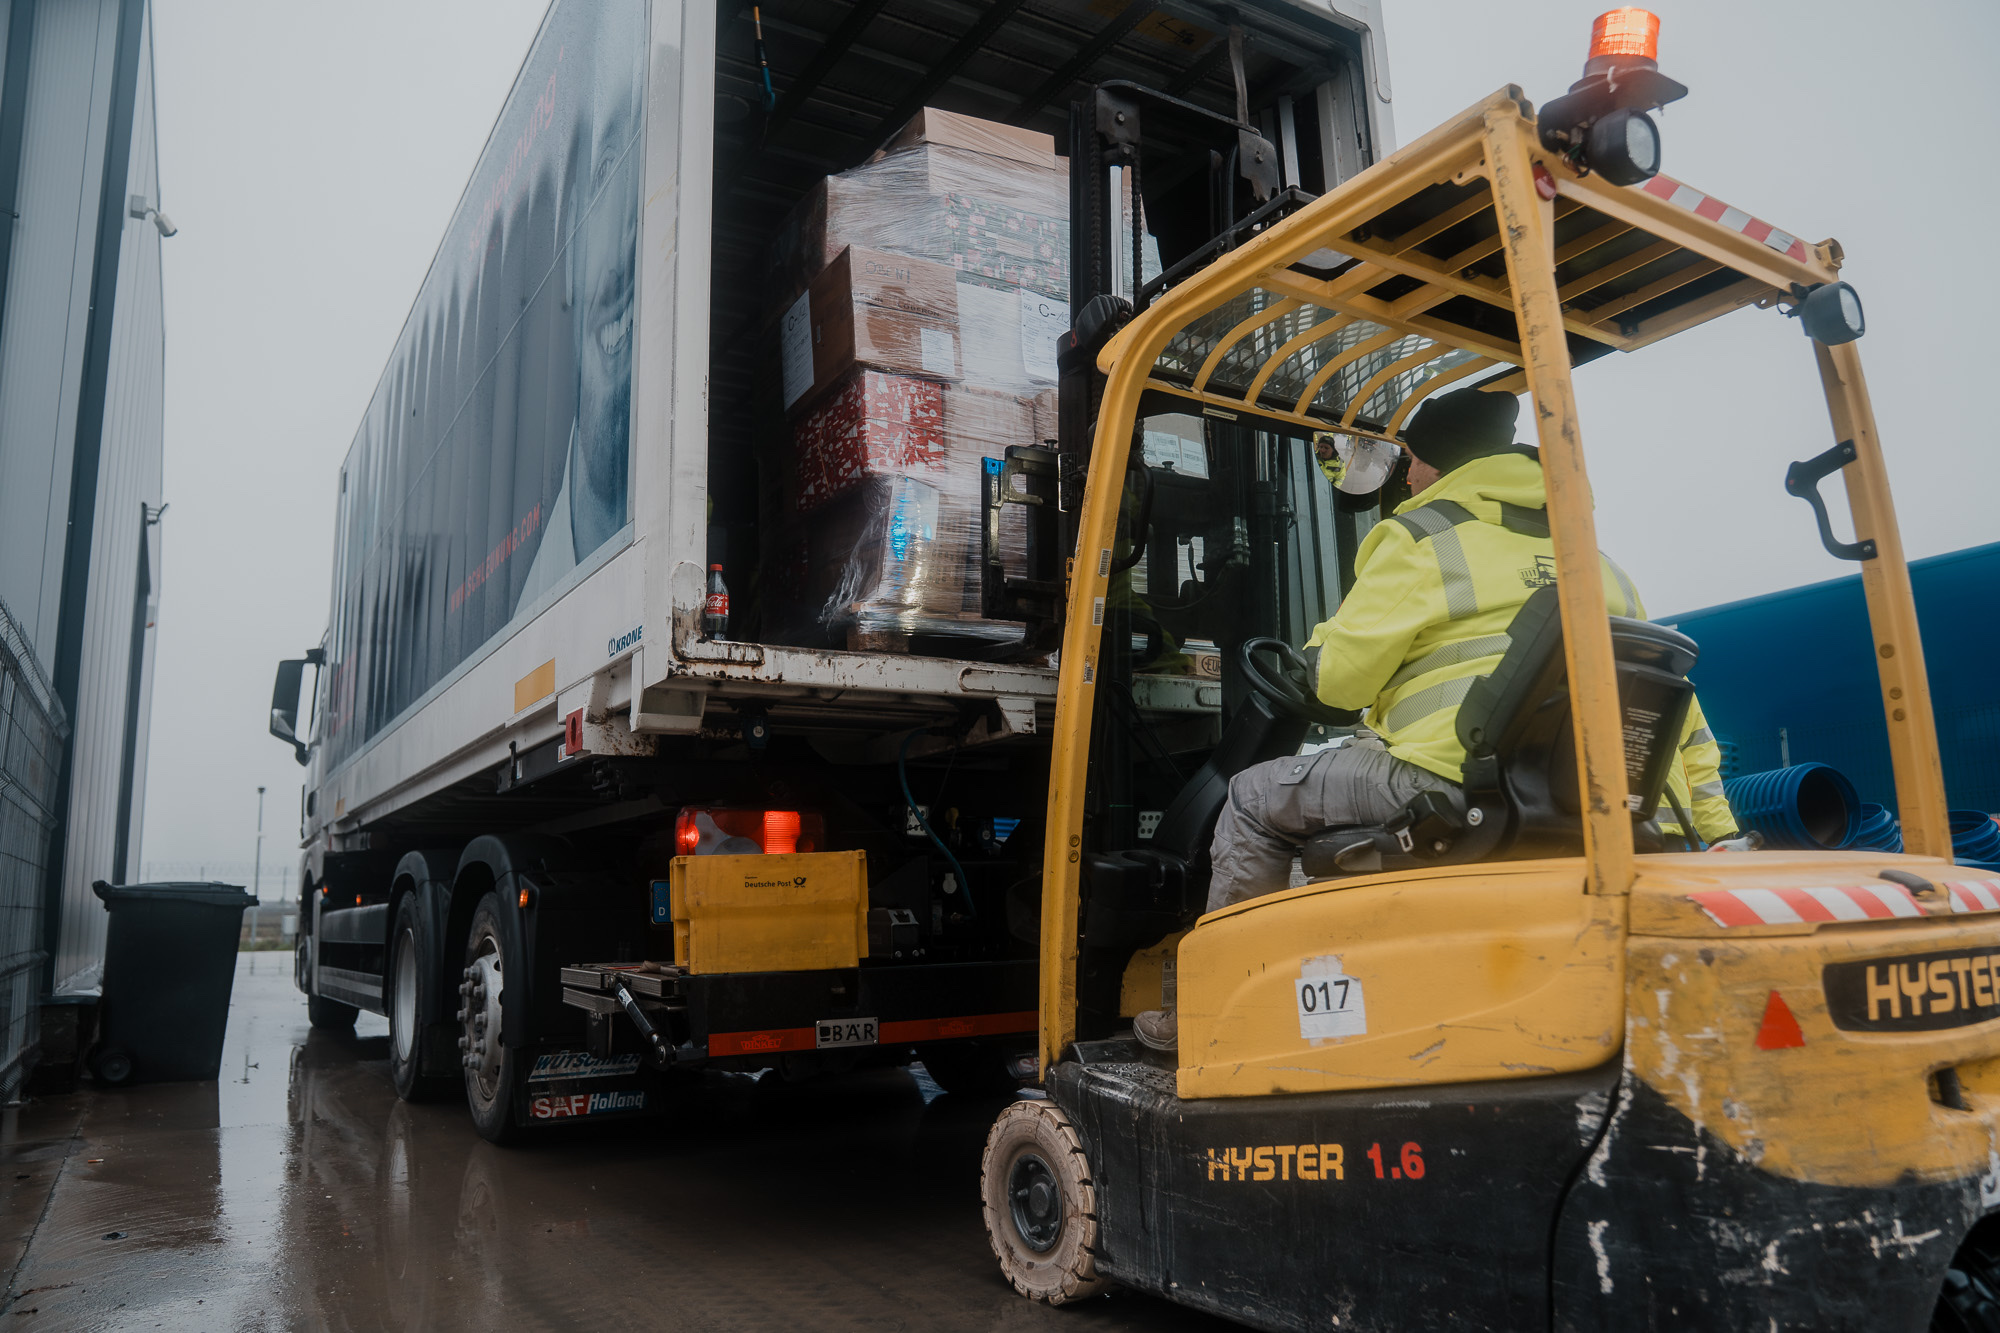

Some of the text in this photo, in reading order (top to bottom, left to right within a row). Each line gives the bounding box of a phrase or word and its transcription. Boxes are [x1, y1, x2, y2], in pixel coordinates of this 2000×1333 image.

[615, 625, 643, 654] KRONE
[658, 906, 666, 916] D
[1301, 979, 1350, 1013] 017
[741, 1039, 781, 1050] DINKEL
[832, 1023, 875, 1042] BÄR
[533, 1091, 645, 1118] SAF Holland
[1206, 1141, 1426, 1182] HYSTER 1.6
